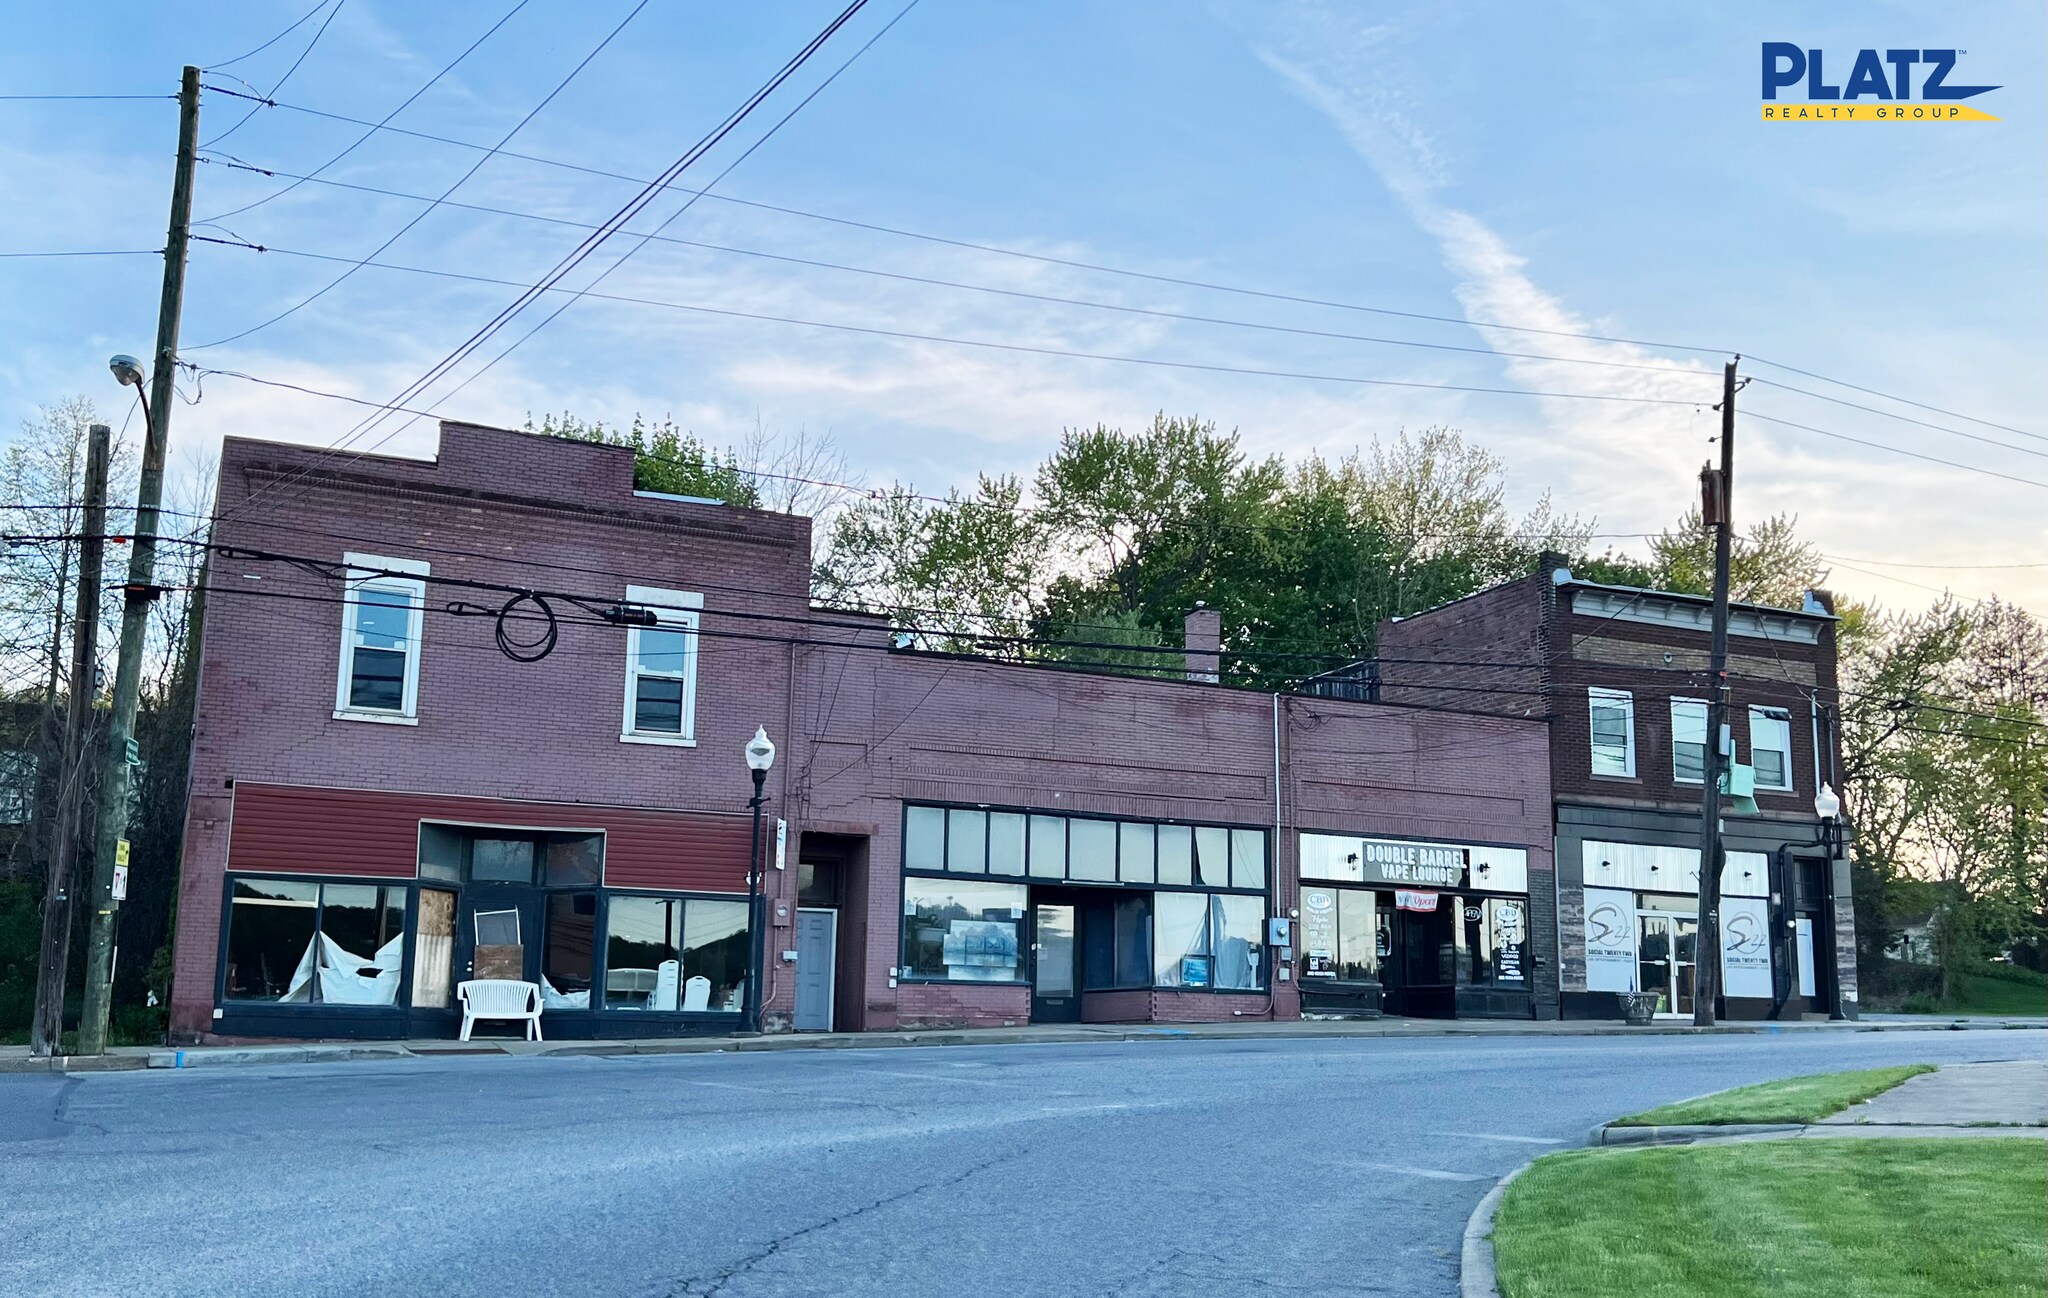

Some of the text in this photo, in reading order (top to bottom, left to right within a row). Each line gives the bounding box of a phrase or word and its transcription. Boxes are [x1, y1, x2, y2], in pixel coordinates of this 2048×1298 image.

[1366, 844, 1467, 869] DOUBLE BARREL
[1381, 863, 1454, 883] VAPE LOUNGE
